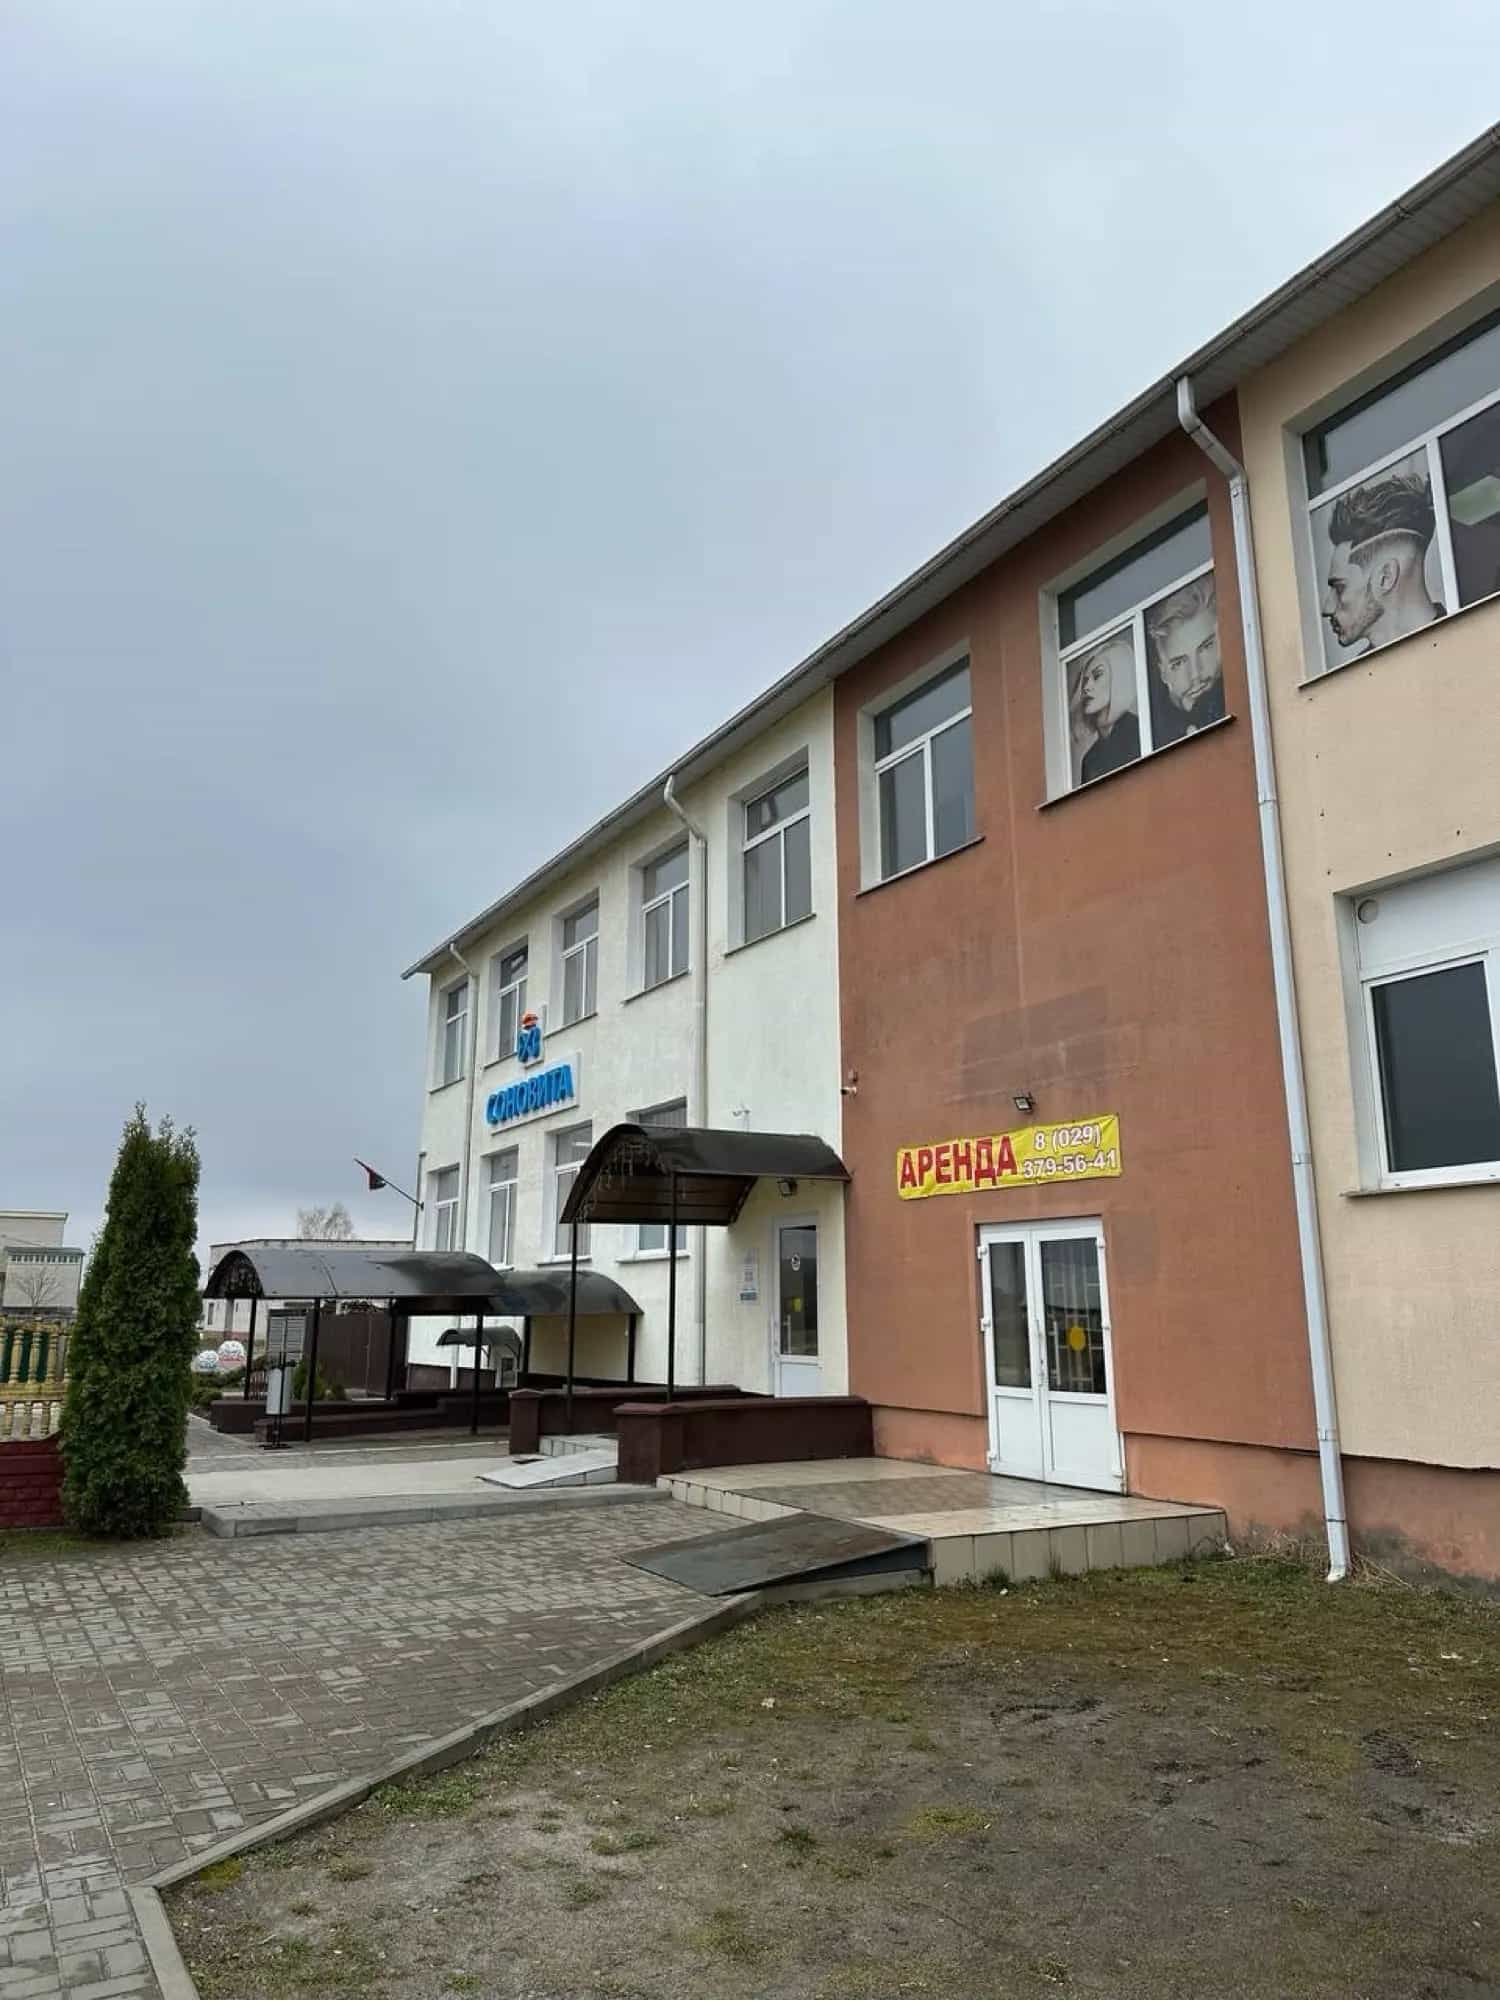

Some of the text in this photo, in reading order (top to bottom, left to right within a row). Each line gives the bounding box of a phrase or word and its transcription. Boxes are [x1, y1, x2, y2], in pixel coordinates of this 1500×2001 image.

[487, 1064, 574, 1125] СОНОВИТА
[1035, 1124, 1101, 1152] 8 (029)
[900, 1136, 1017, 1188] АРЕНДА
[1023, 1150, 1117, 1179] 379-56-41
